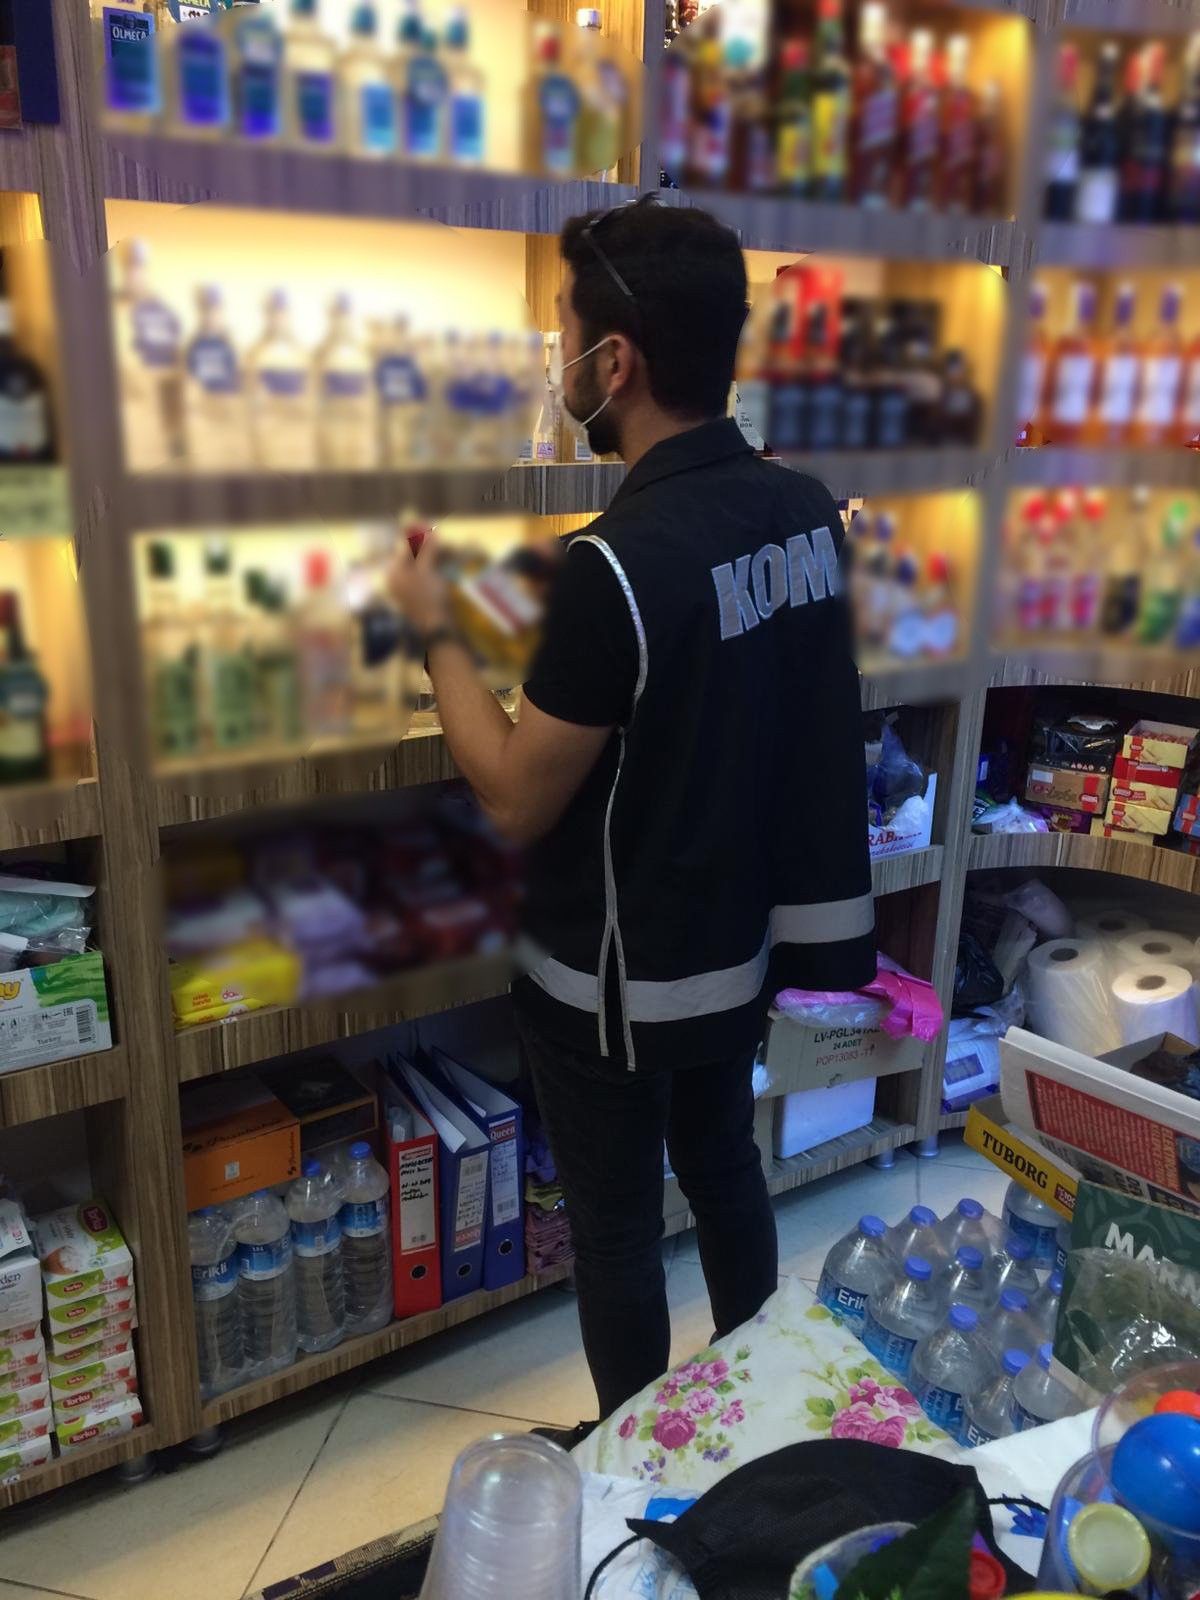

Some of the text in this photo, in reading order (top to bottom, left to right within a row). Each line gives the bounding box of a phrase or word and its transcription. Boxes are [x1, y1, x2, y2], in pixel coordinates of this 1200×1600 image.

[711, 526, 838, 641] KOM
[490, 1126, 516, 1142] Queen
[982, 1130, 1049, 1189] TUBORG
[66, 1393, 91, 1407] Torku
[72, 1427, 98, 1443] Torku
